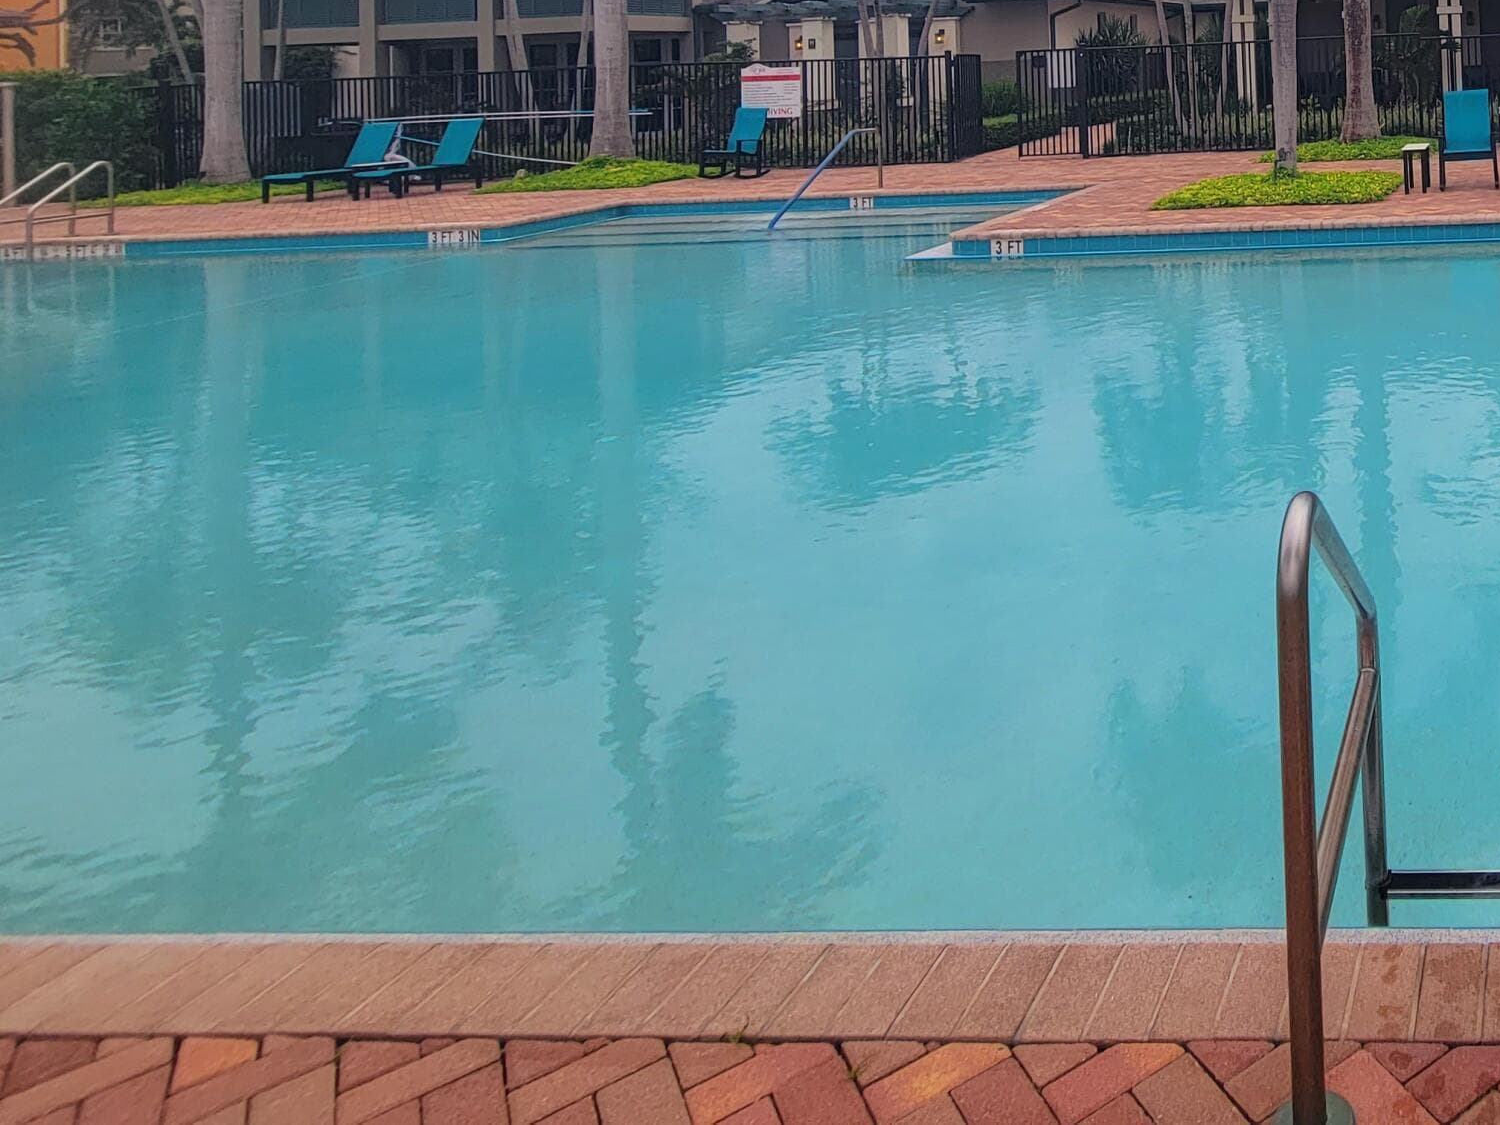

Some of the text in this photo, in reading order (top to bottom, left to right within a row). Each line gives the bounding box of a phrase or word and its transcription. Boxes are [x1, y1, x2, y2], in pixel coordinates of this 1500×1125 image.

[768, 107, 793, 115] IVING
[862, 196, 872, 209] FT
[431, 229, 480, 243] 3 FT 3 IN
[995, 240, 1022, 255] 3 FT
